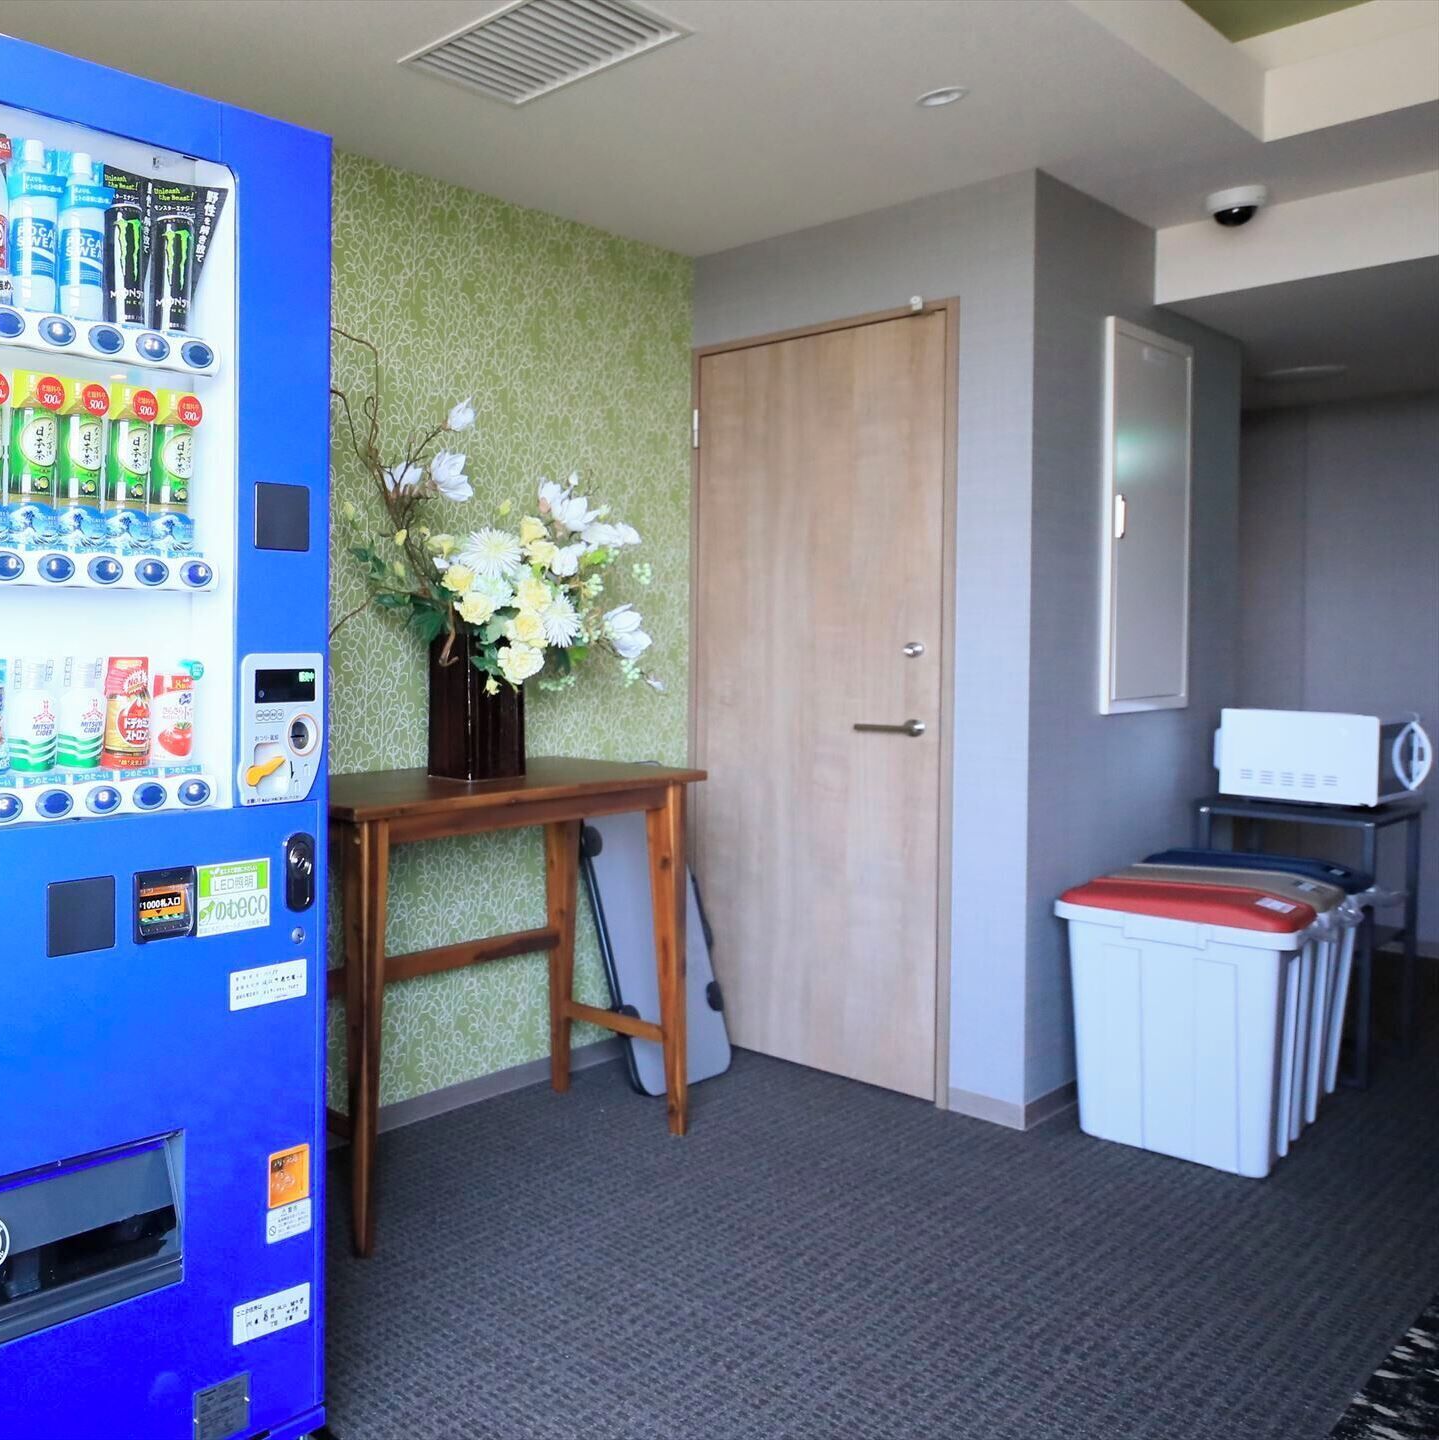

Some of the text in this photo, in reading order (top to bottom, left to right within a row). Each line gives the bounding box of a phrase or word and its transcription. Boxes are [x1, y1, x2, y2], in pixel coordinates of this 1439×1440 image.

[154, 187, 181, 195] Unleash
[17, 222, 57, 240] POCA
[16, 237, 55, 249] SWEA
[66, 231, 103, 247] POCA
[65, 244, 103, 258] SWEA
[125, 717, 149, 729] ドデカミ
[83, 726, 101, 734] CIDER
[126, 729, 148, 740] ストロン
[215, 875, 254, 891] LED照明
